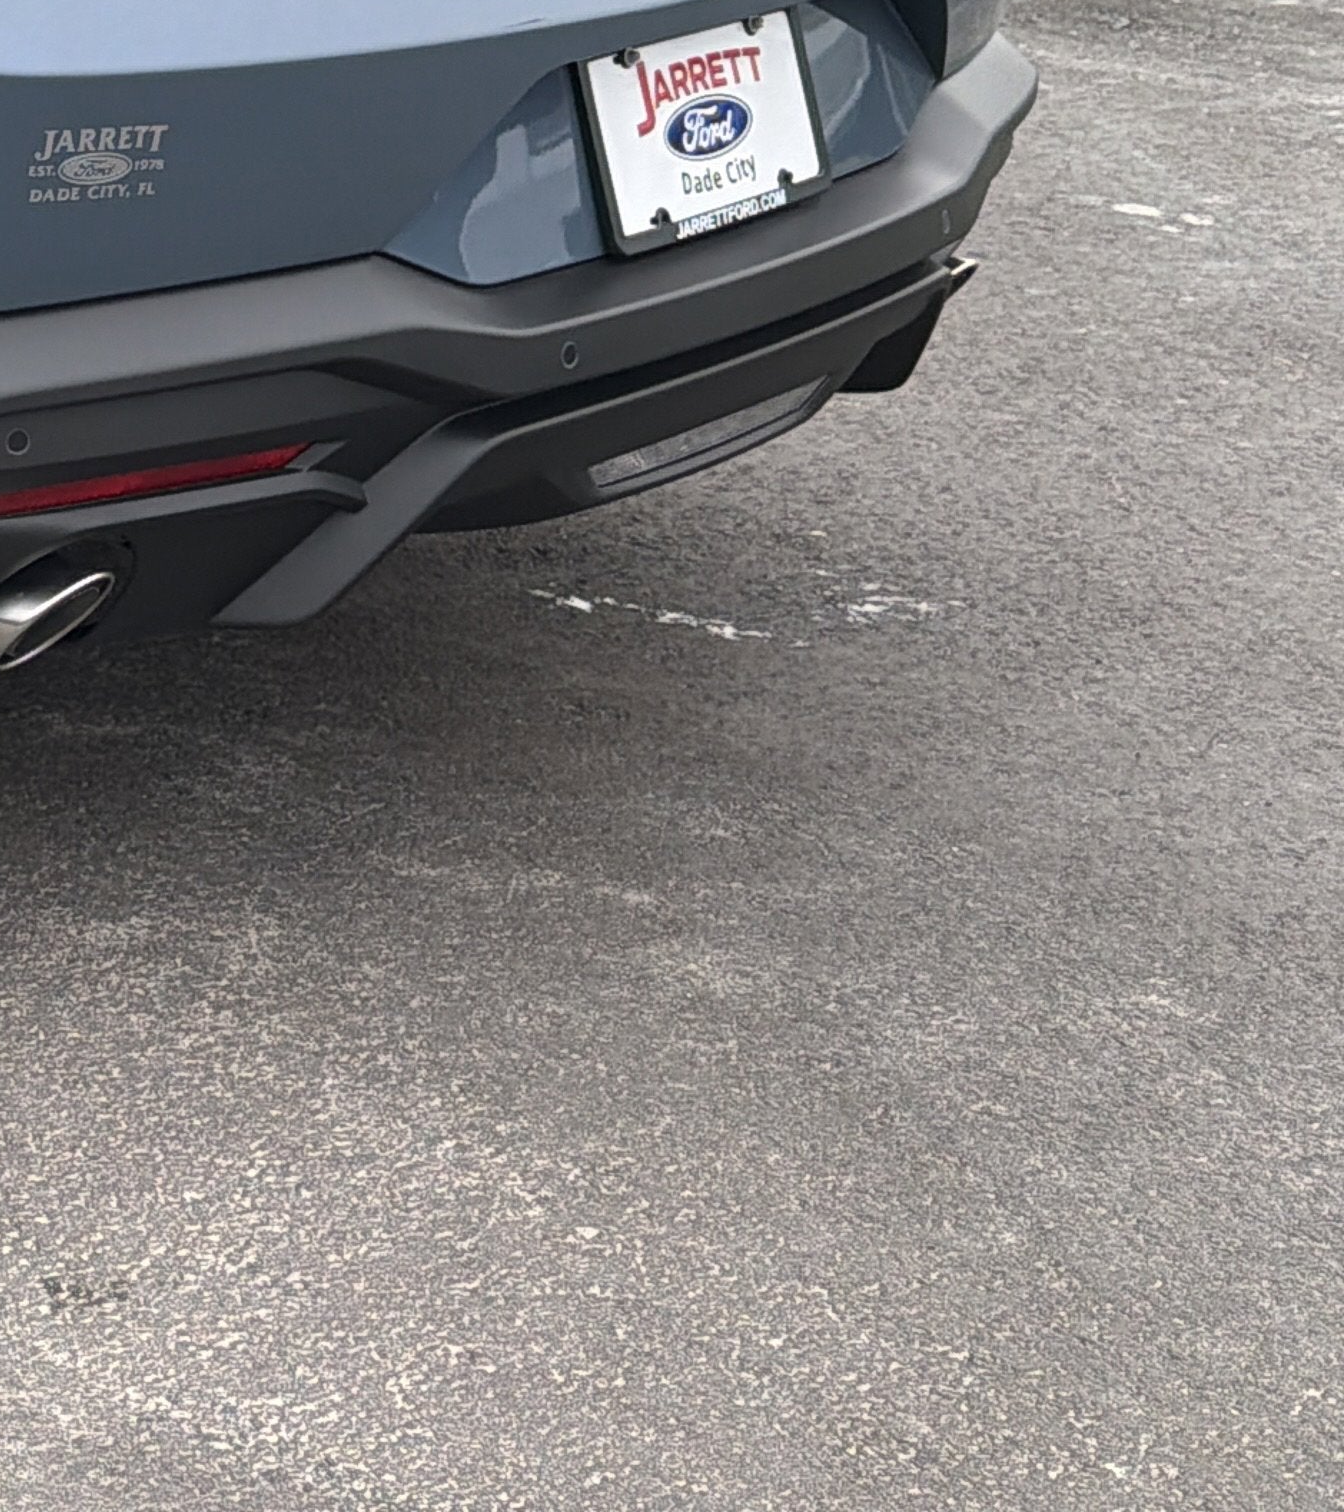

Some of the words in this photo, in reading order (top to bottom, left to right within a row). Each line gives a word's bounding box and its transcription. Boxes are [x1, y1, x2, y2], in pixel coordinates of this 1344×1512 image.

[636, 46, 761, 138] JARRETT
[34, 124, 169, 161] JARRETT
[682, 103, 736, 153] Ford
[28, 165, 56, 178] EST.
[28, 187, 81, 203] DADE
[87, 184, 130, 200] CITY,
[137, 181, 156, 196] FL
[681, 168, 723, 196] Dade
[725, 155, 758, 185] City
[676, 188, 787, 240] JARRETTFORD.COM
